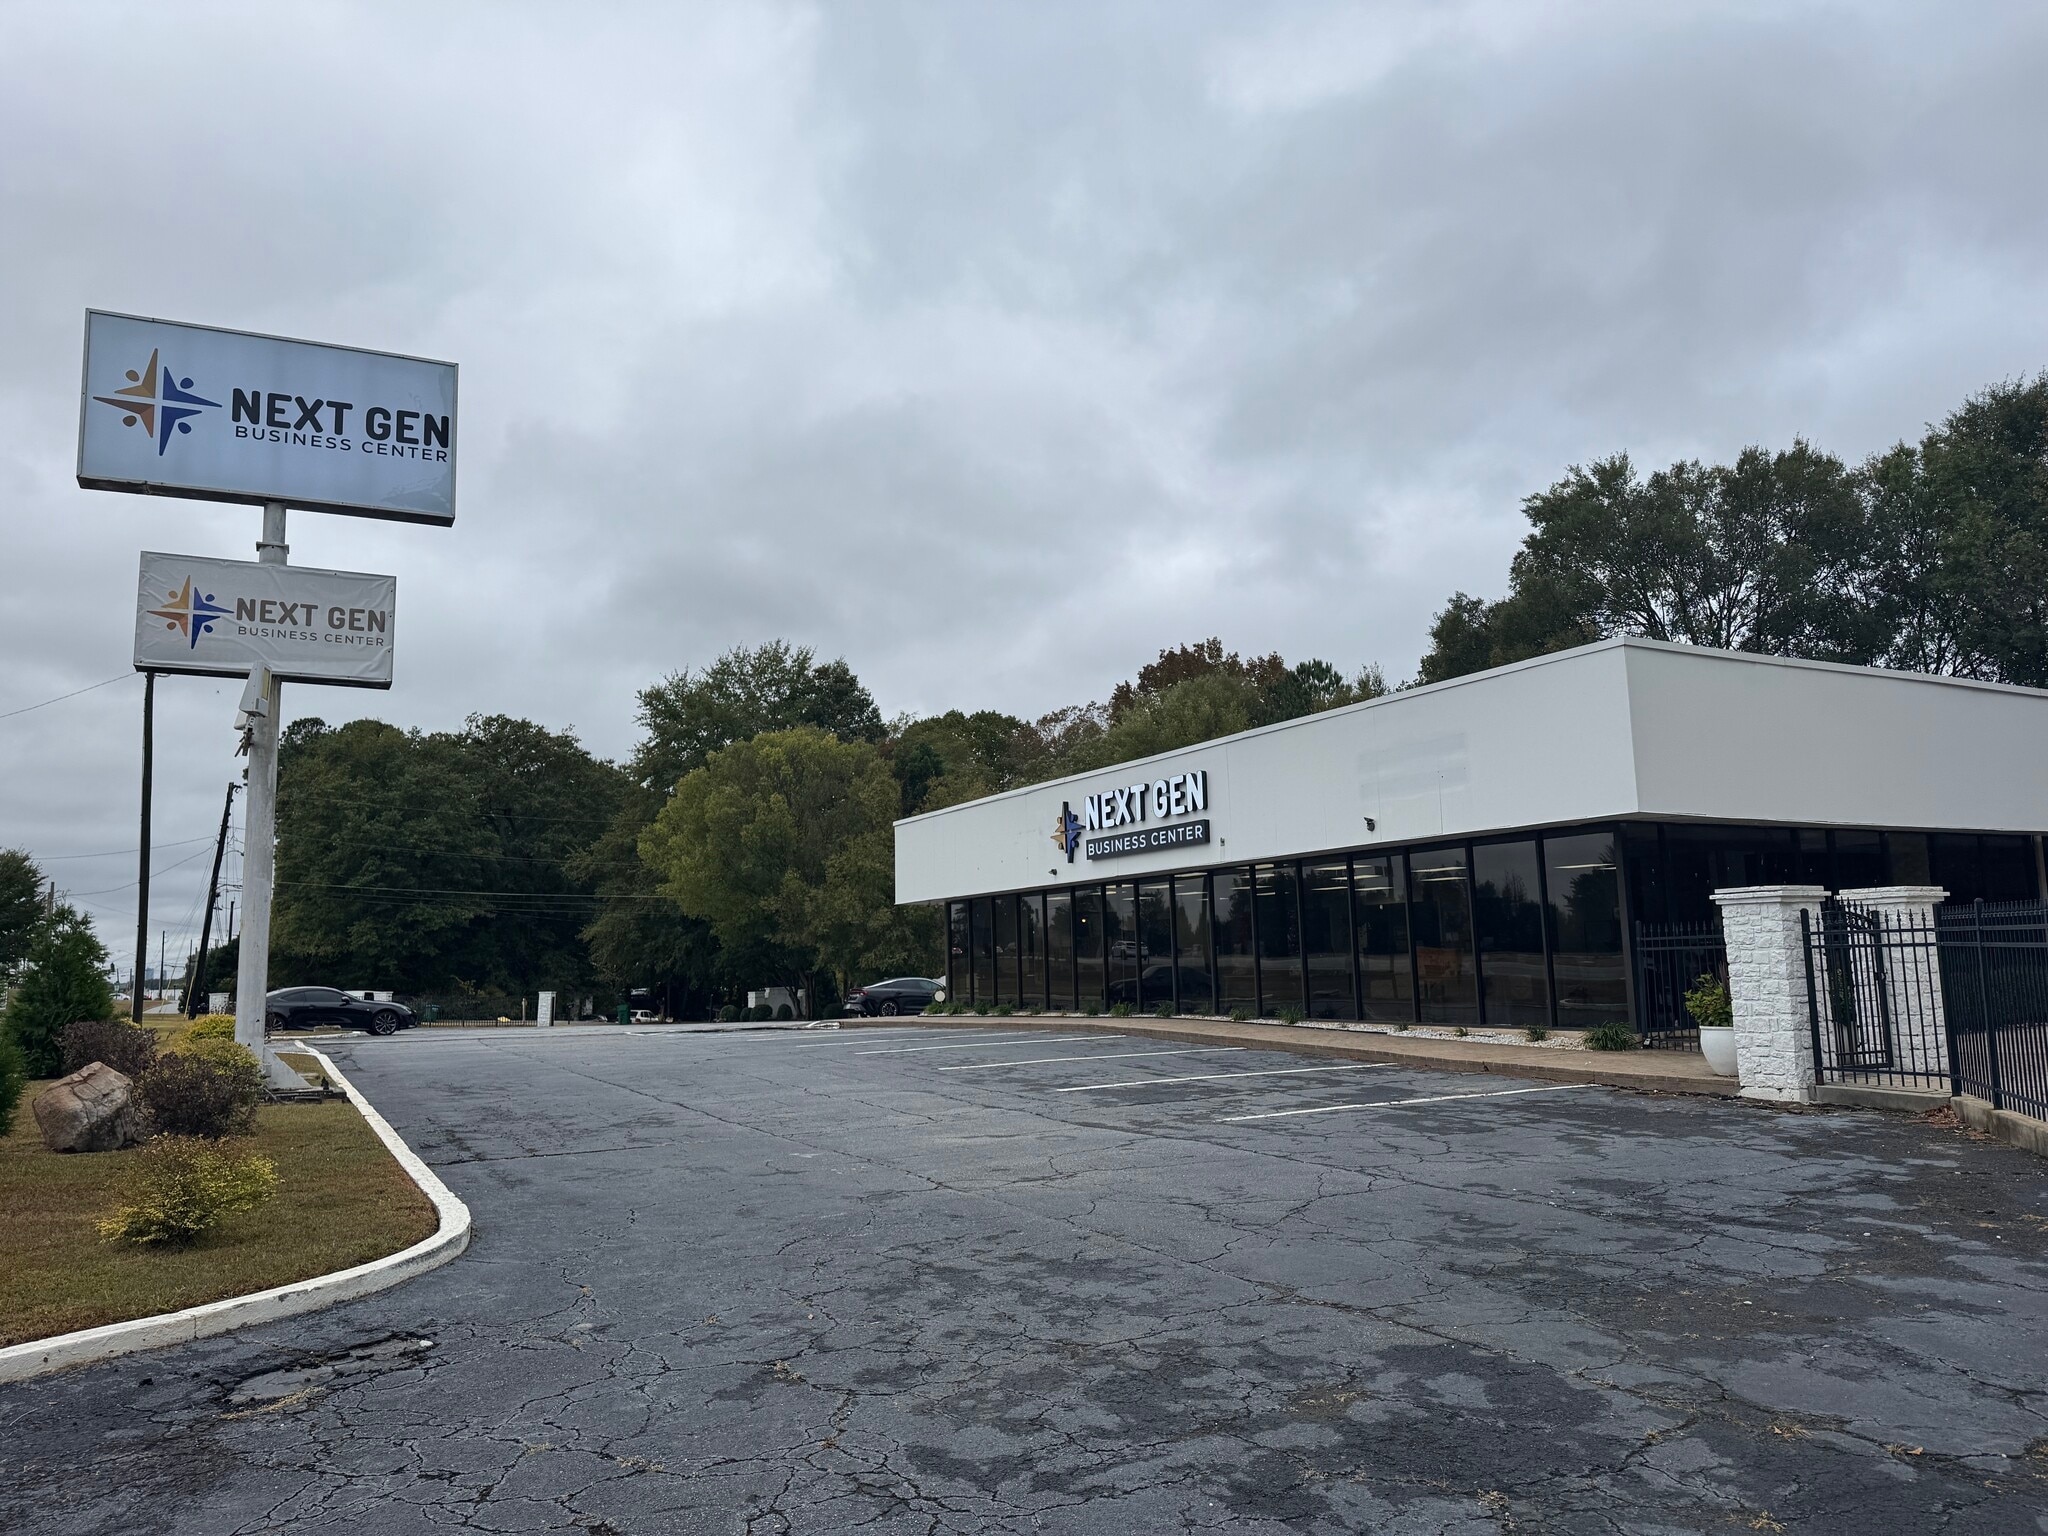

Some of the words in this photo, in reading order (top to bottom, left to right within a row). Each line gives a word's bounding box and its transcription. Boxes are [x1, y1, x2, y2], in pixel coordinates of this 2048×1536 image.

[231, 387, 353, 436] NEXT
[365, 406, 449, 449] GEN
[235, 425, 352, 452] BUSINESS
[361, 440, 448, 463] CENTER
[235, 597, 319, 628] NEXT
[327, 606, 386, 633] GEN
[237, 626, 318, 642] BUSINESS
[324, 633, 385, 647] CENTER
[1084, 783, 1149, 831] NEXT
[1152, 770, 1207, 818] GEN
[1088, 834, 1146, 856] BUSINESS
[1151, 825, 1203, 846] CENTER
